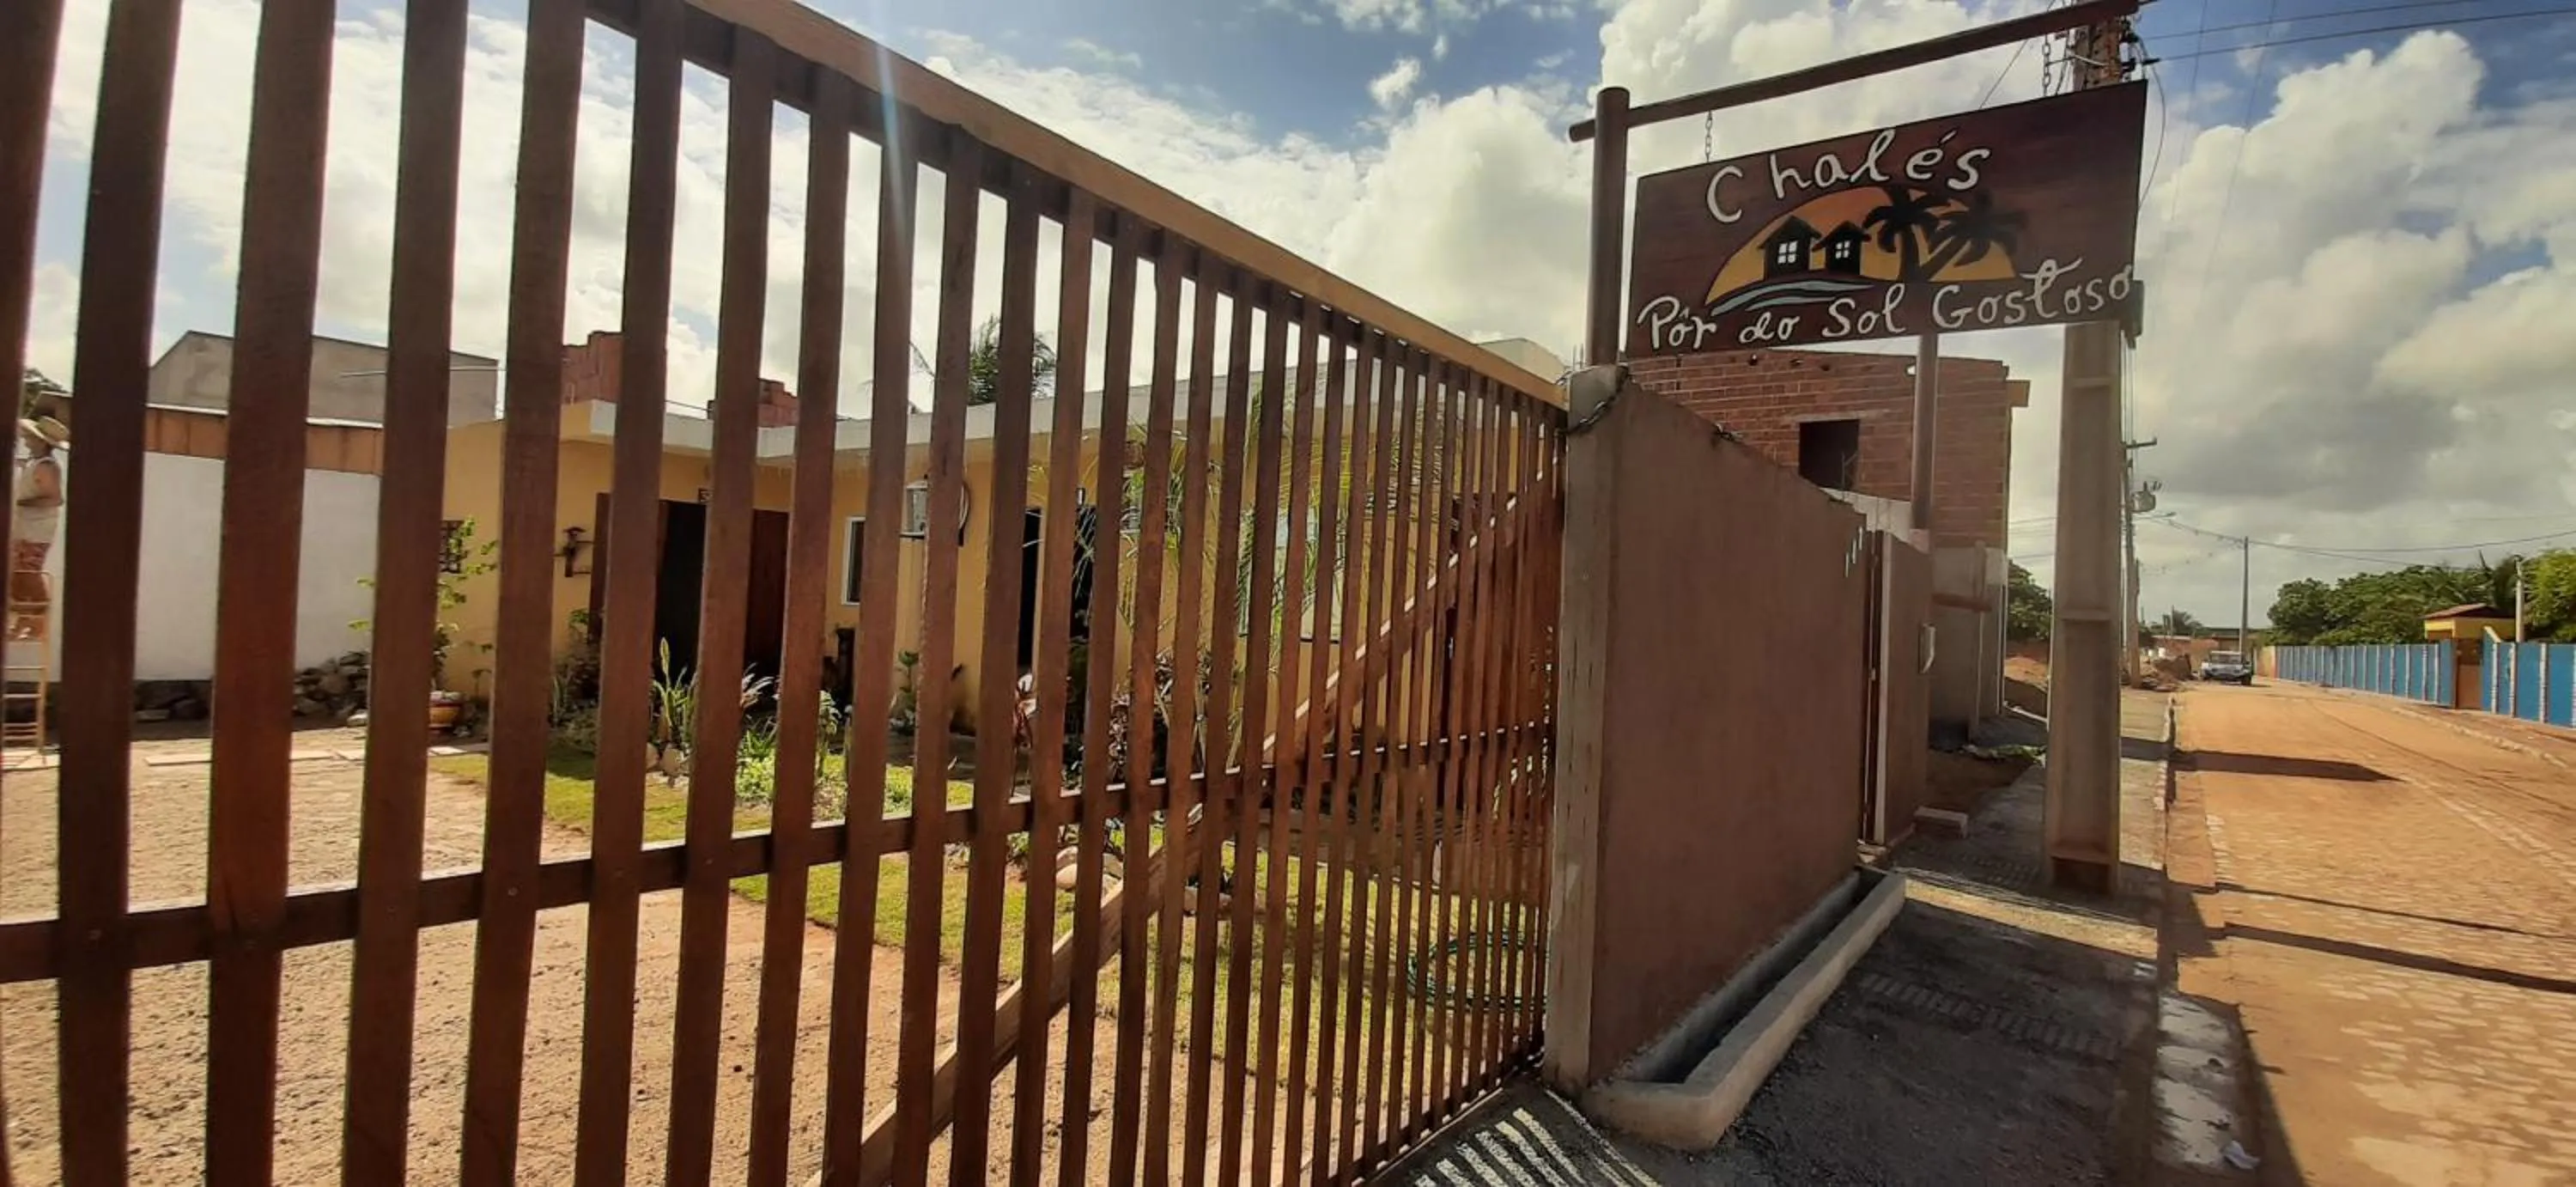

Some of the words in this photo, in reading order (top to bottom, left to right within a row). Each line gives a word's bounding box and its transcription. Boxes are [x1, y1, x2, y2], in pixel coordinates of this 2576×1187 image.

[1706, 129, 1991, 223] Chalés
[1739, 312, 1800, 343] do
[1821, 283, 1906, 338] Sol
[1932, 258, 2133, 328] Gostoso
